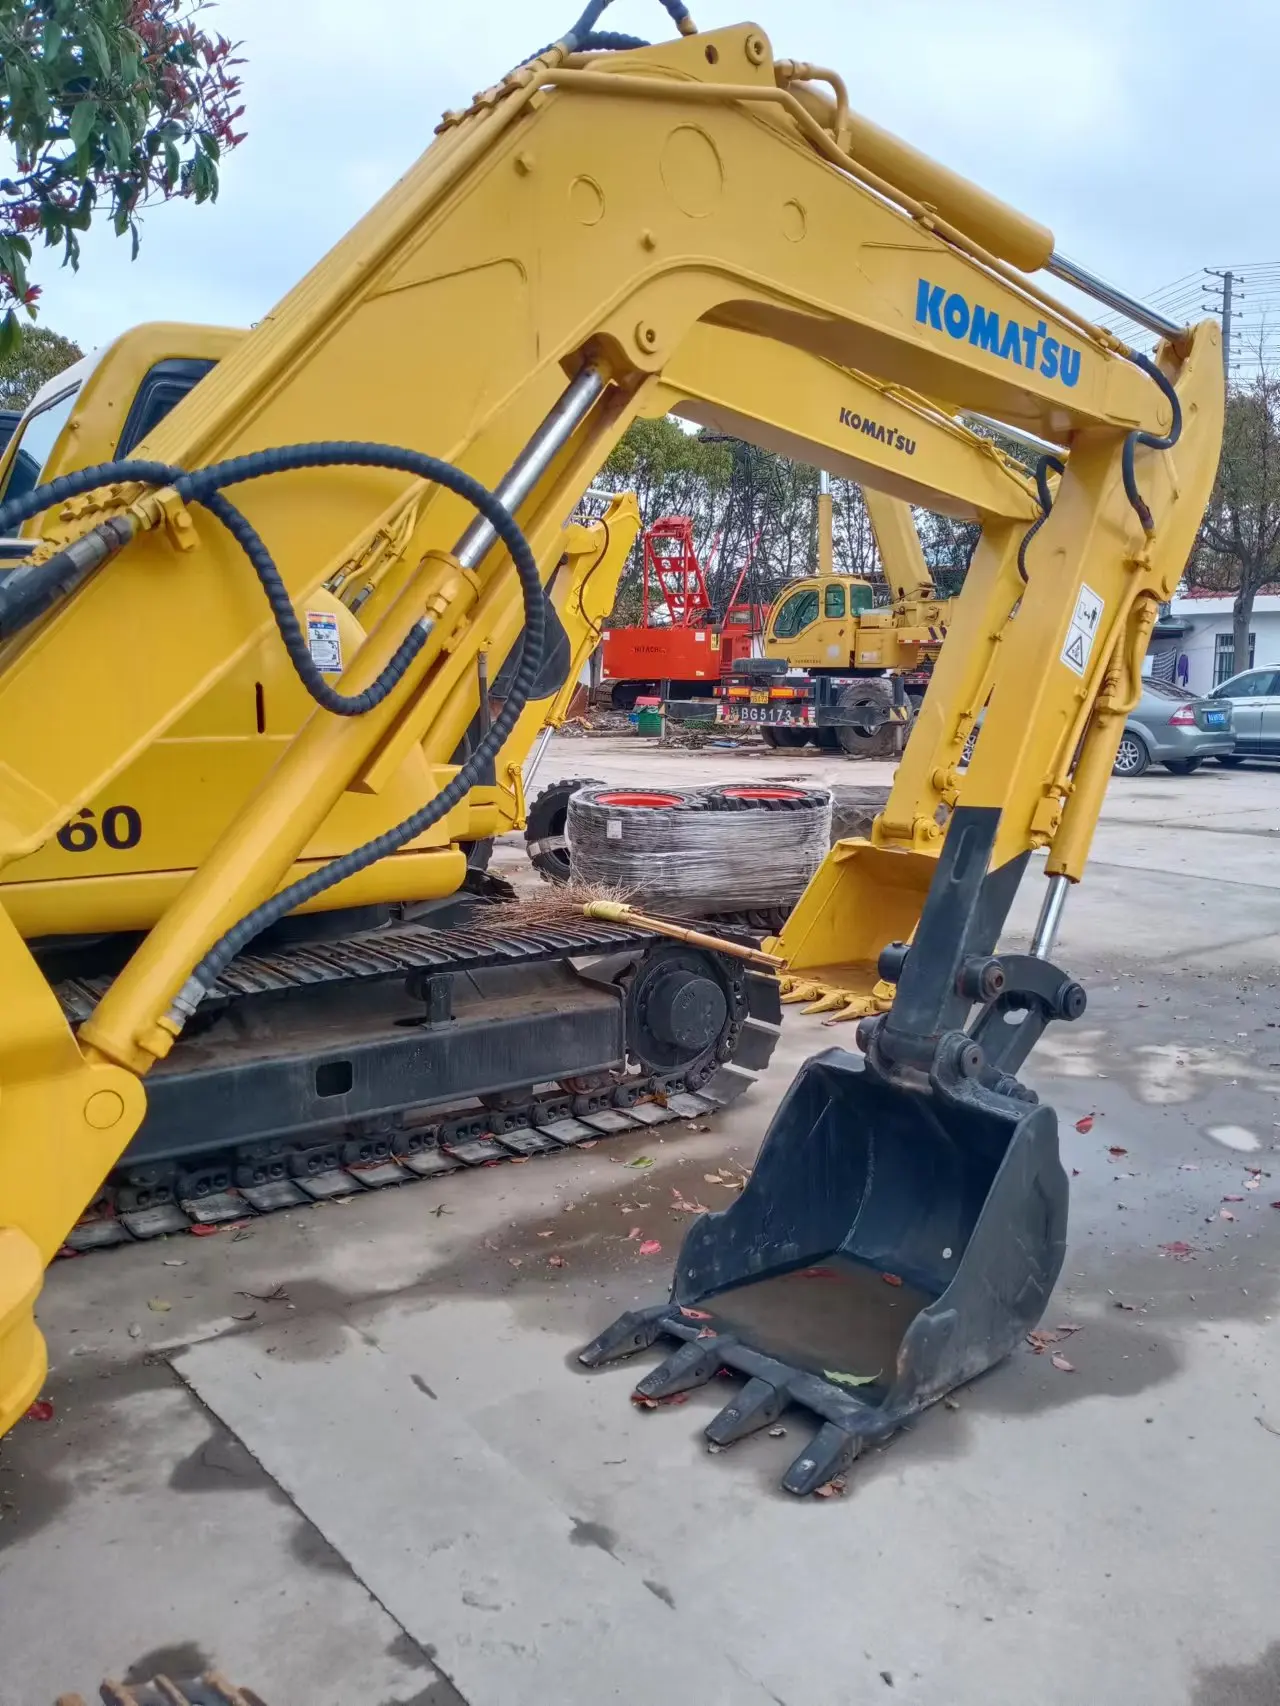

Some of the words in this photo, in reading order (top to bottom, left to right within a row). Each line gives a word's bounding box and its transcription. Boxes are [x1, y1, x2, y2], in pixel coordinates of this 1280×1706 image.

[916, 278, 1081, 388] KOMATSU
[839, 406, 916, 456] KOMATSU
[741, 707, 793, 723] BG5173
[56, 805, 142, 852] 60
